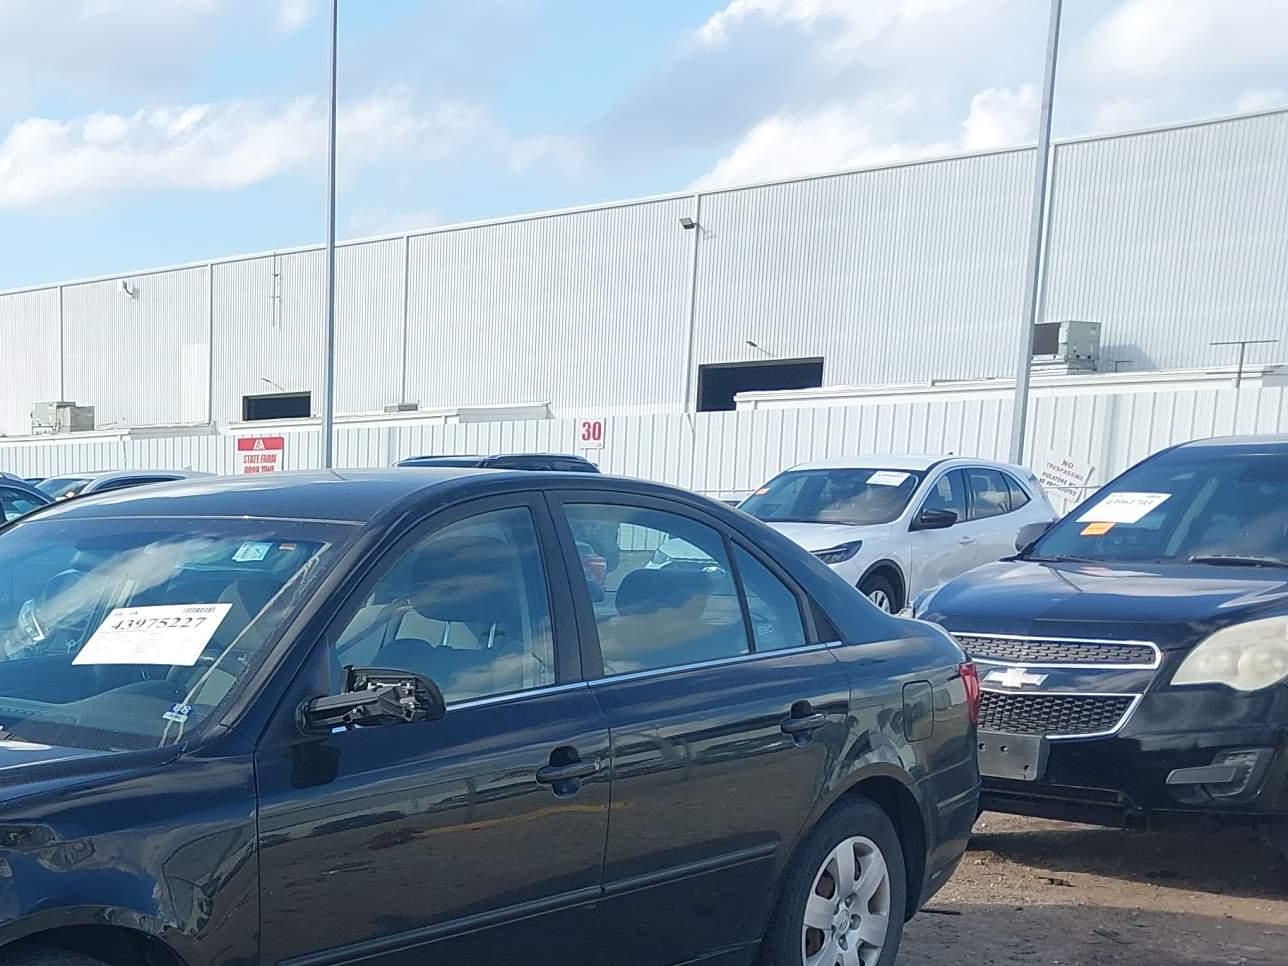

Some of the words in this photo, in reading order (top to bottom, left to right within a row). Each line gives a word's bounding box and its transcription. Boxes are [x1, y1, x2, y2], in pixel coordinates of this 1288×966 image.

[582, 421, 601, 440] 30
[243, 455, 260, 464] STATE
[1062, 459, 1074, 469] NO
[112, 617, 207, 631] 43975227
